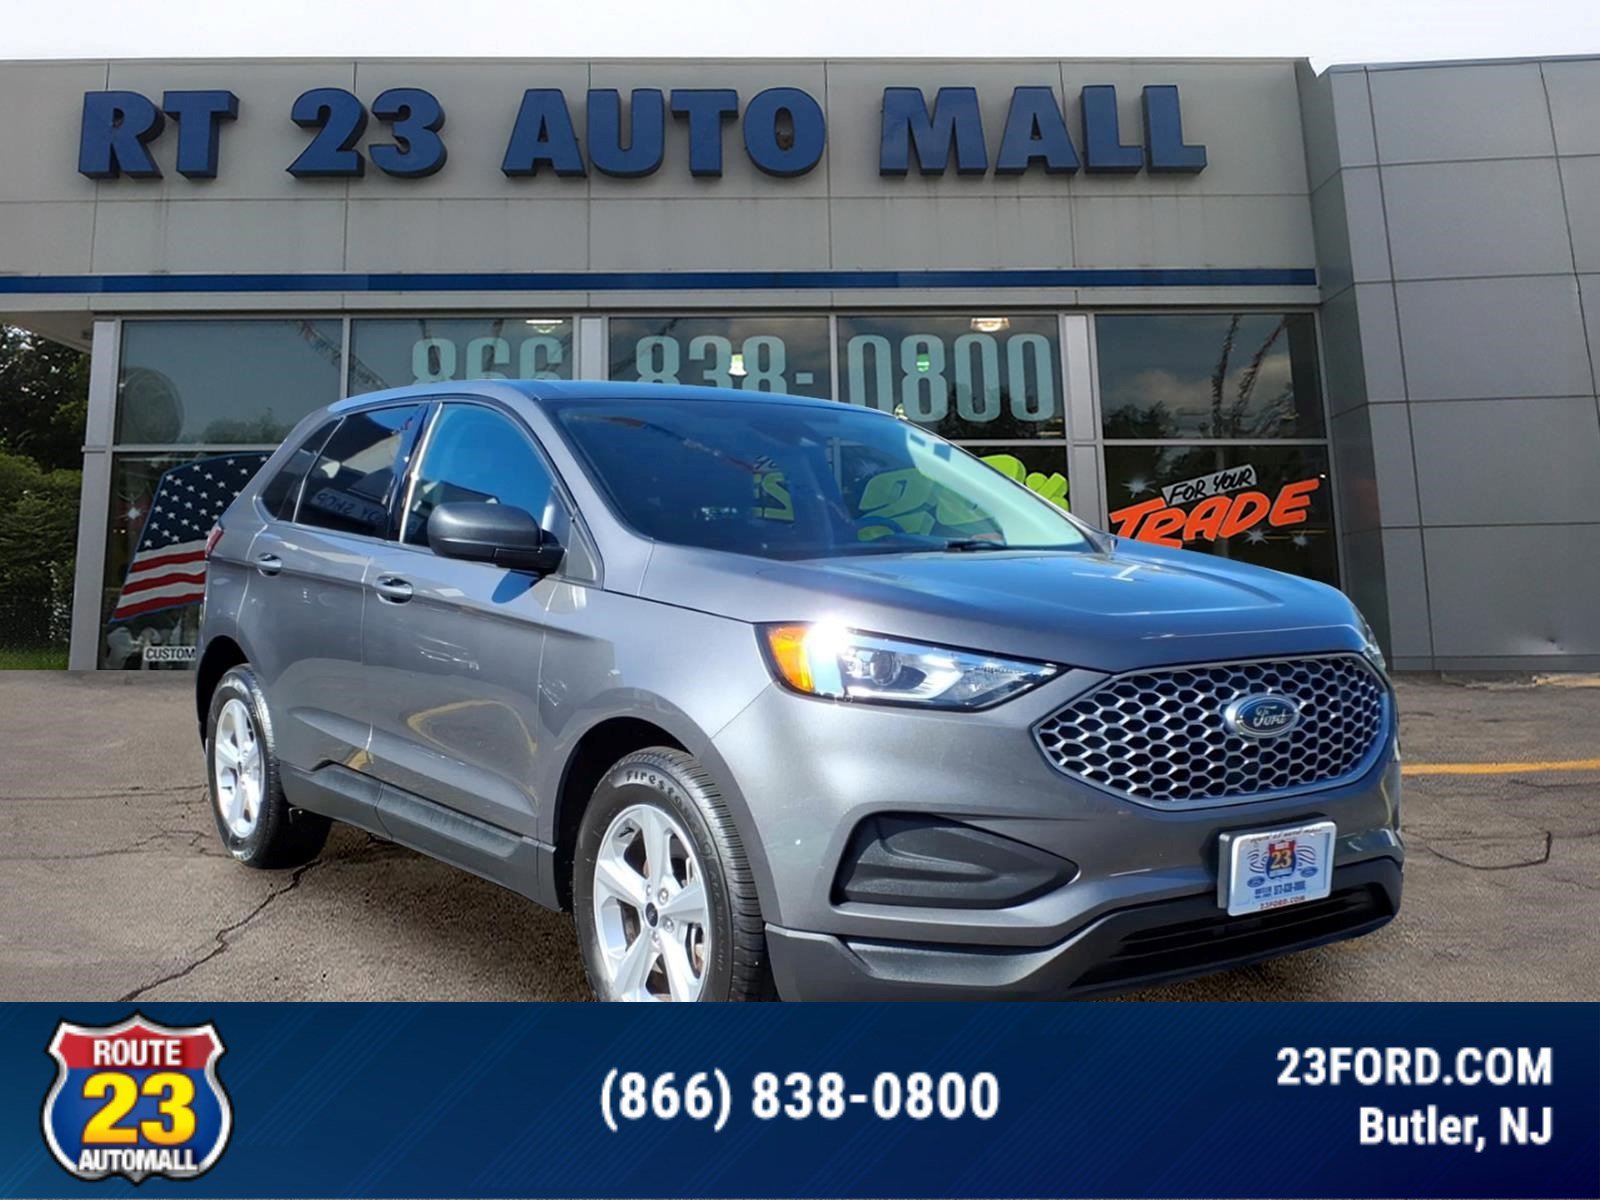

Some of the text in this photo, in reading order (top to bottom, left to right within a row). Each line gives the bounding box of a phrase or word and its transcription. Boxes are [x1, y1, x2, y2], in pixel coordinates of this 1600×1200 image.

[78, 85, 1207, 179] RT 23 AUTO MALL
[1169, 469, 1252, 504] FOR YOUR
[1109, 479, 1319, 549] TRADE
[146, 648, 196, 660] CUSTOM
[1253, 705, 1290, 728] Ford
[1270, 850, 1292, 870] 23
